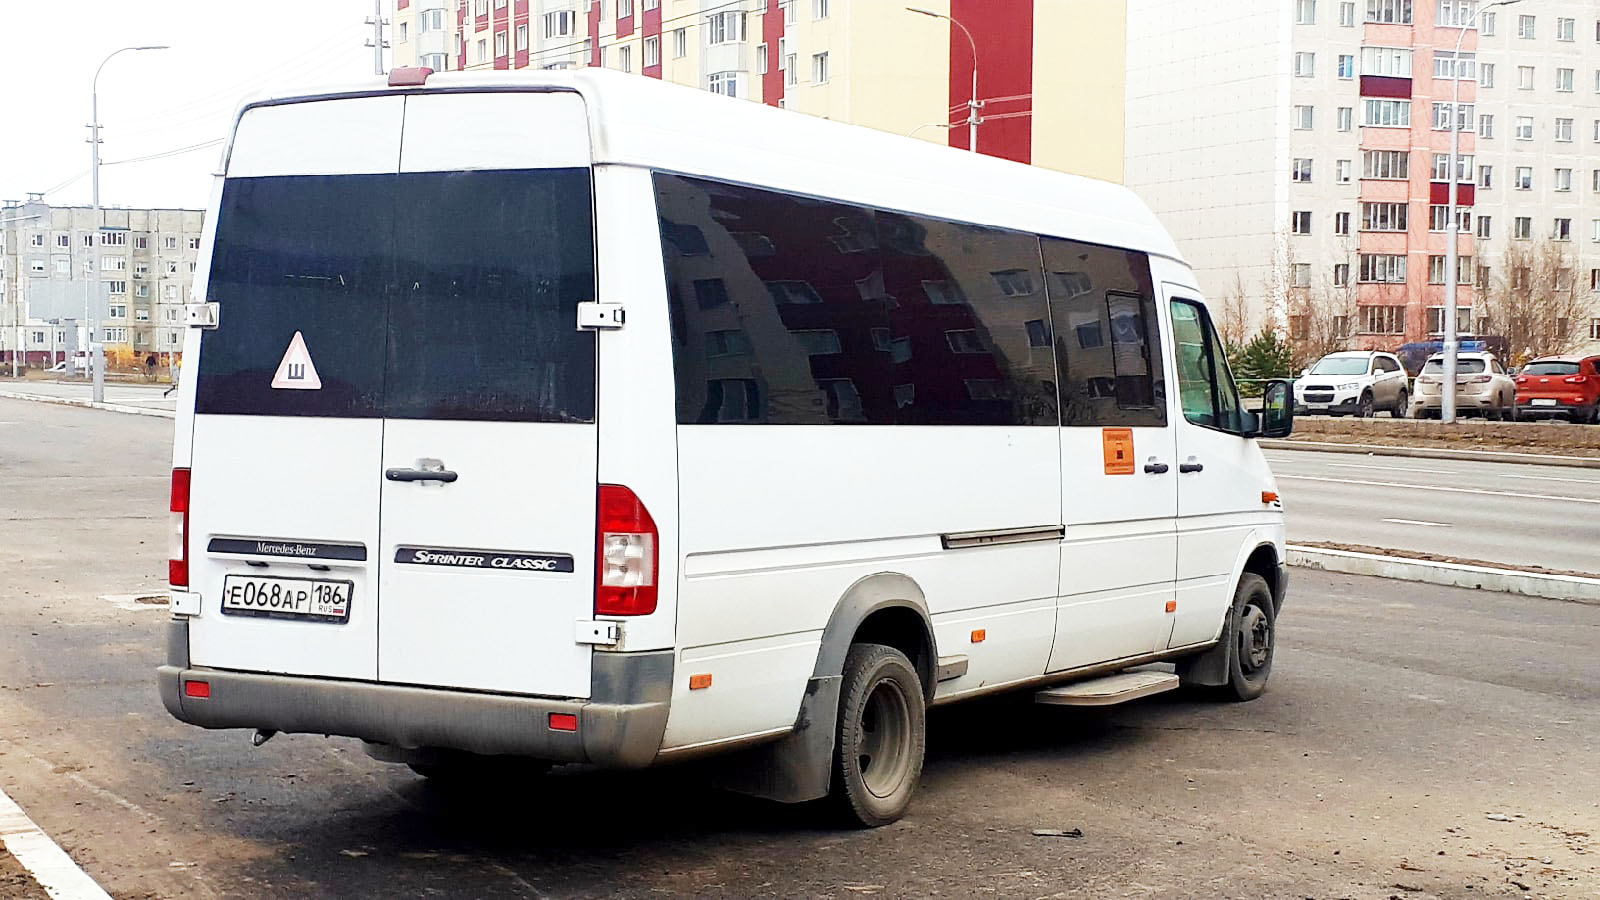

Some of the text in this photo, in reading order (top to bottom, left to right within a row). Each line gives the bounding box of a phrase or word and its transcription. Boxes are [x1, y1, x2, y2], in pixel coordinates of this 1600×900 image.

[256, 542, 317, 556] Mercedes-Benz
[412, 550, 557, 570] SPRINTER CLASSIC
[314, 584, 342, 605] 186
[318, 605, 333, 613] RUS
